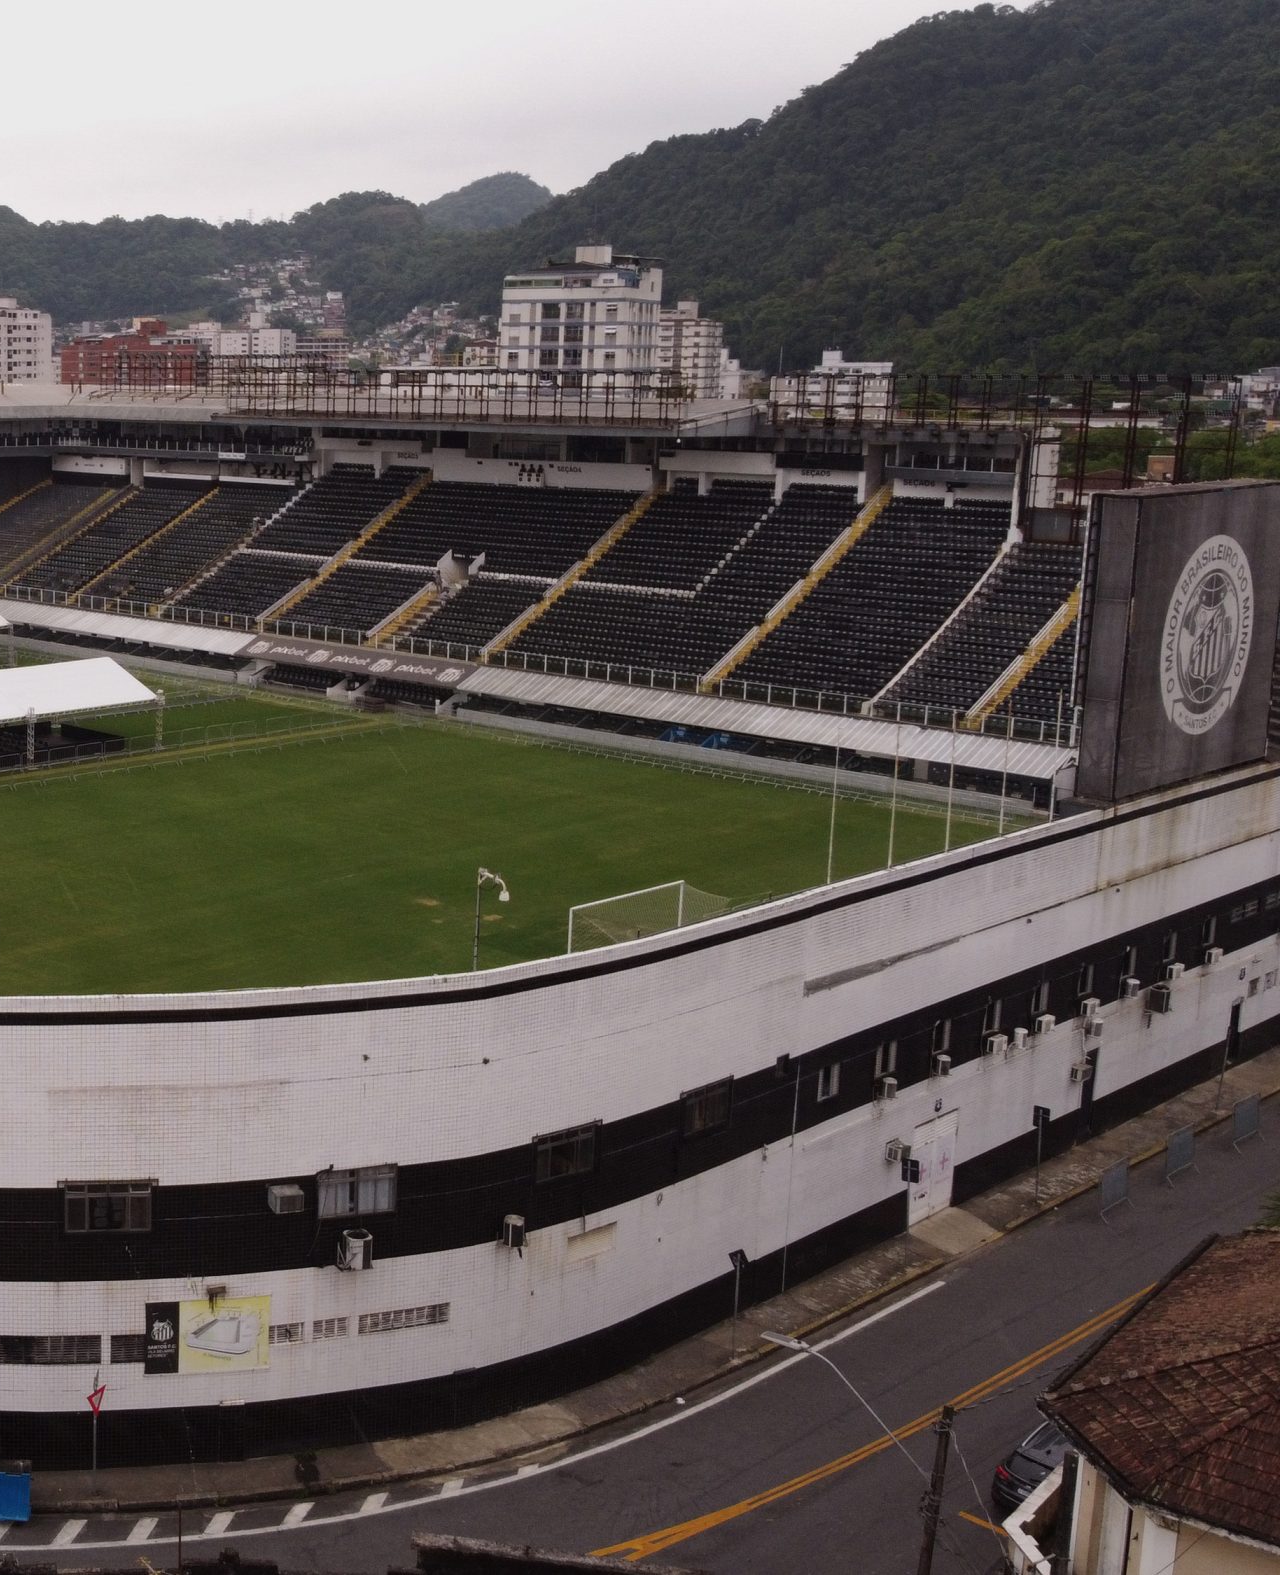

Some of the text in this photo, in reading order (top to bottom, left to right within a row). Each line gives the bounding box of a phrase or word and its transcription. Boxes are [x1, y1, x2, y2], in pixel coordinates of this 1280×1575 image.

[1181, 543, 1239, 595] BRASILEIRO
[1237, 564, 1248, 592] DO
[269, 646, 437, 675] pixbet pixbet pixbet
[1164, 598, 1183, 673] MAIOR
[1233, 596, 1250, 677] MUNDO
